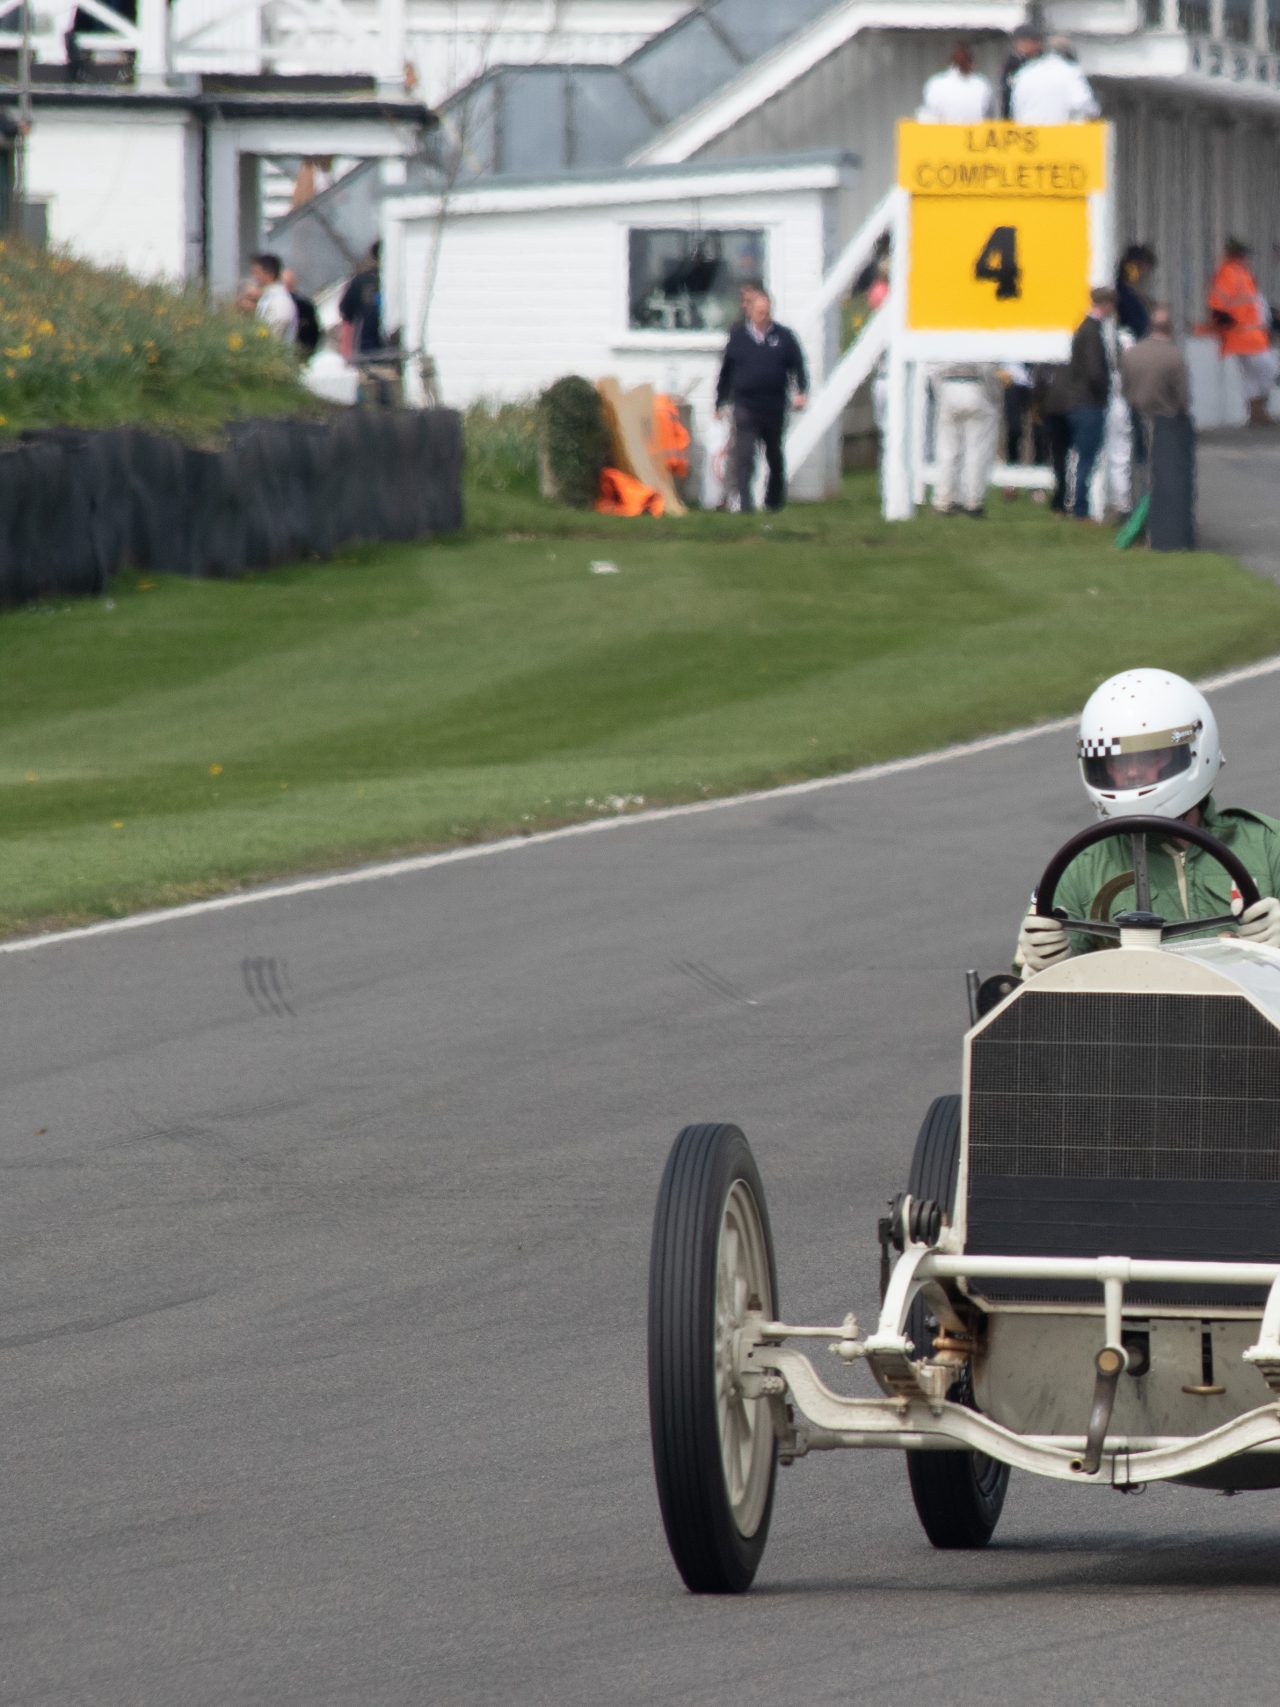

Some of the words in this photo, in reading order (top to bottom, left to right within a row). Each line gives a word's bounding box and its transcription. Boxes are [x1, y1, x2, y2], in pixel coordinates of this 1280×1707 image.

[966, 129, 1038, 152] LAPS
[915, 162, 1087, 190] COMPLETED
[974, 225, 1021, 301] 4
